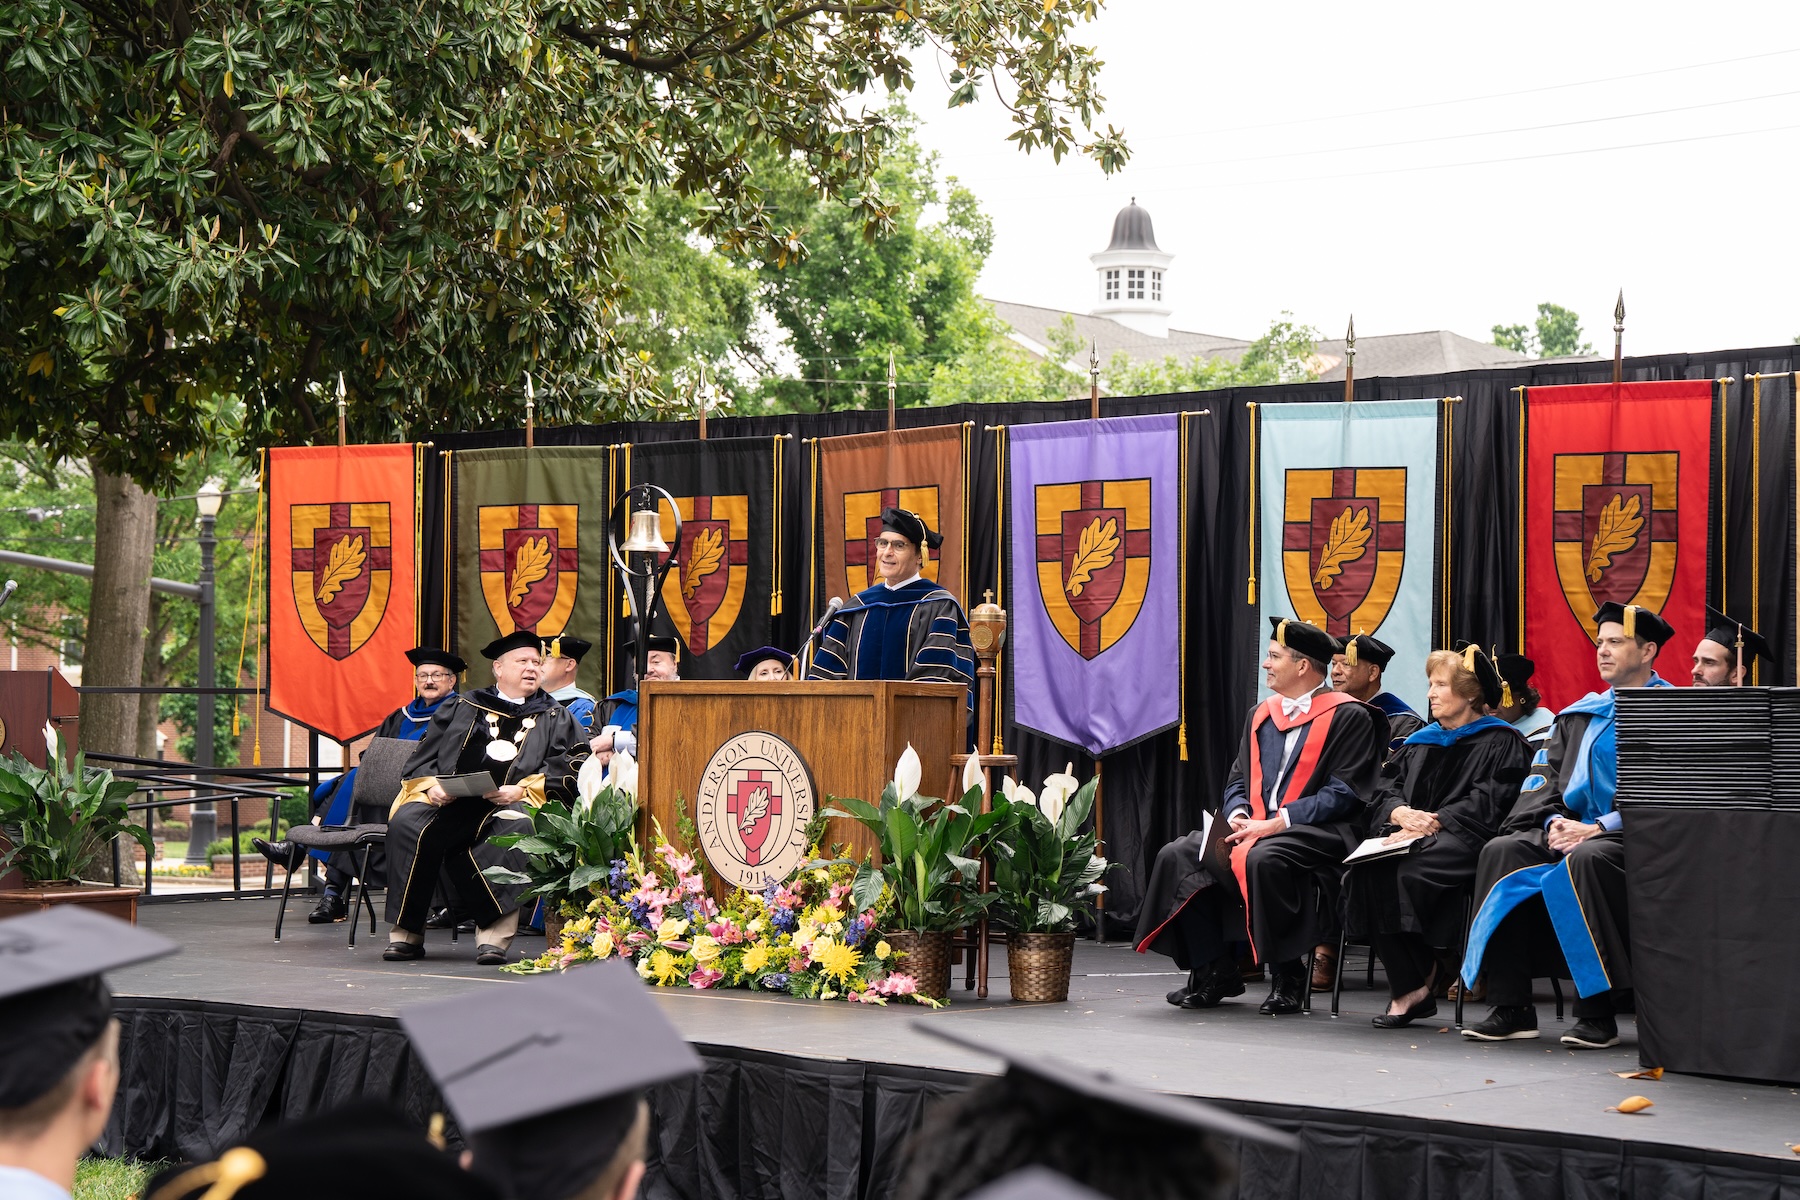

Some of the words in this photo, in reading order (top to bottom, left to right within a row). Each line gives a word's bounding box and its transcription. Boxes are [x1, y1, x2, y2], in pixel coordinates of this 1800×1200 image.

[702, 740, 748, 849] ANDERSON
[760, 740, 808, 856] UNIVERSITY
[739, 870, 767, 884] 1911
